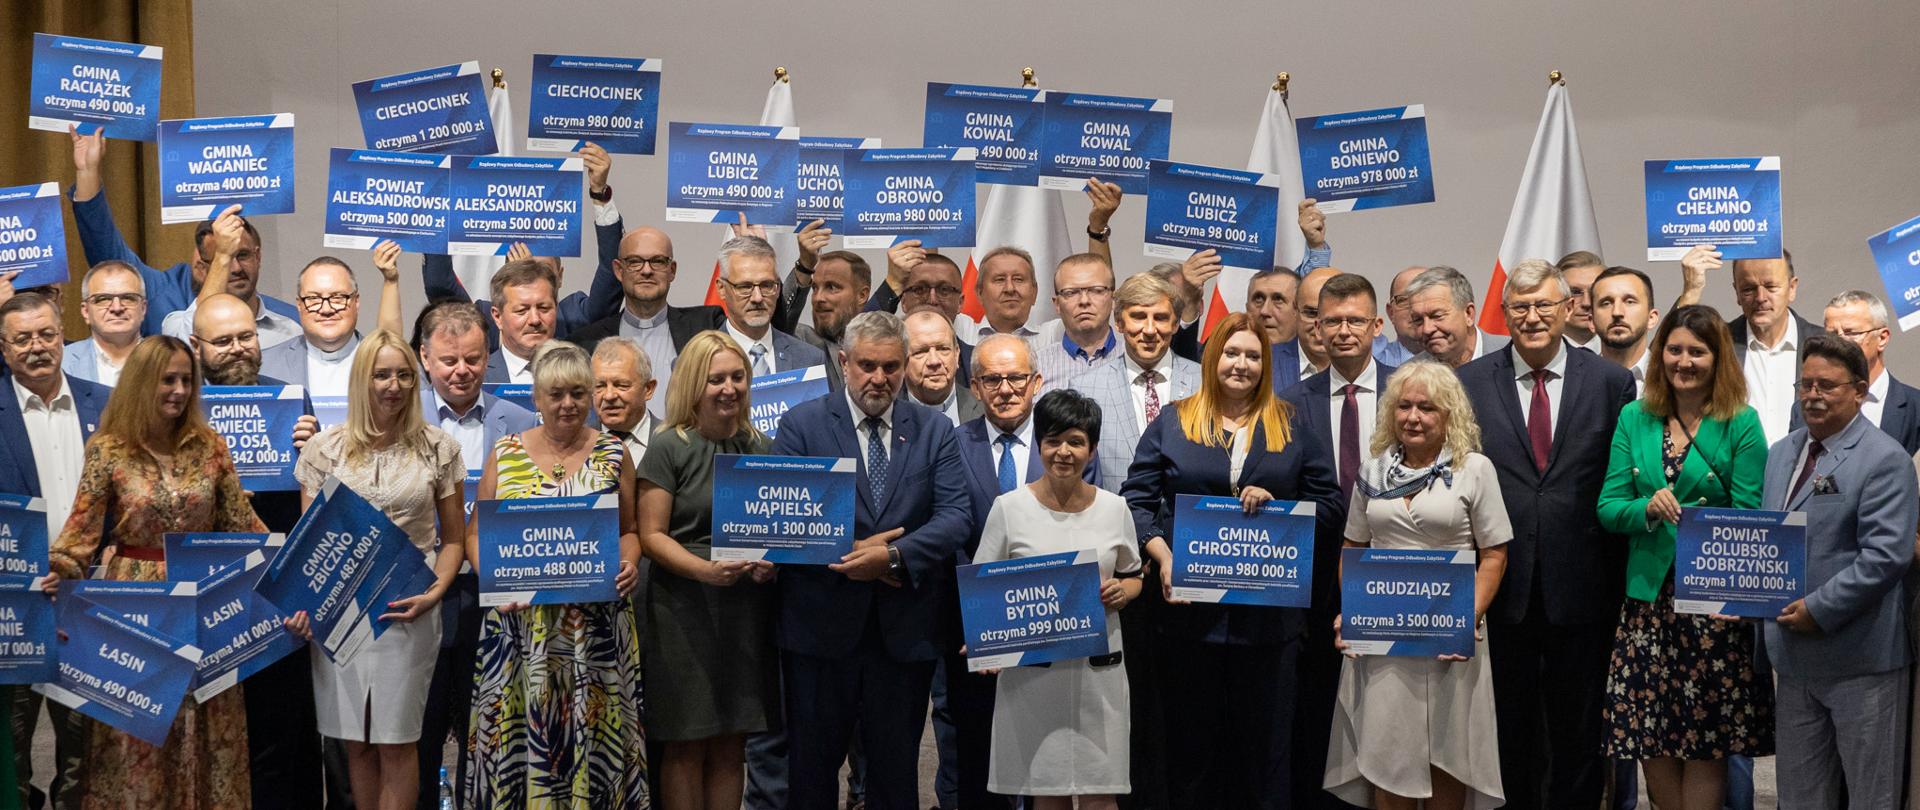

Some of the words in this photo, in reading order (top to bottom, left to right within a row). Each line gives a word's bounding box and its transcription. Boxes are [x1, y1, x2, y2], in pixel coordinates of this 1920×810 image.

[73, 65, 120, 81] GMINA
[61, 78, 131, 98] RACIĄŻEK
[548, 84, 642, 100] CIECHOCINEK
[44, 95, 87, 109] otrzyma
[88, 98, 110, 111] 490
[112, 101, 134, 114] 000
[135, 104, 145, 115] zł
[376, 92, 470, 120] CIECHOCINEK
[543, 115, 585, 128] otrzyma
[587, 115, 608, 128] 980
[611, 116, 632, 129] 000
[634, 118, 643, 129] zł
[966, 112, 1013, 127] GMINA
[375, 134, 418, 149] otrzyma
[419, 129, 426, 141] 1
[428, 125, 449, 139] 200
[451, 121, 473, 135] 000
[474, 119, 485, 131] zł
[964, 126, 1014, 142] KOWAL
[1084, 122, 1130, 137] GMINA
[203, 144, 253, 159] GMINA
[1081, 136, 1131, 151] KOWAL
[1340, 137, 1388, 154] GMINA
[709, 151, 757, 166] GMINA
[981, 145, 1003, 158] 490
[1005, 147, 1026, 160] 000
[1028, 149, 1038, 161] zł
[1331, 150, 1399, 169] BONIEWO
[188, 158, 267, 174] WAGANIEC
[1054, 154, 1096, 167] otrzyma
[1099, 155, 1120, 168] 500
[1122, 156, 1143, 169] 000
[708, 166, 758, 180] LUBICZ
[1317, 176, 1360, 188] otrzyma
[1361, 170, 1383, 183] 978
[1385, 167, 1406, 181] 000
[1408, 166, 1418, 178] zł
[176, 182, 220, 194] otrzyma
[222, 177, 244, 190] 400
[246, 176, 268, 189] 000
[270, 176, 280, 188] zł
[366, 178, 424, 194] POWIAT
[885, 176, 934, 189] GMINA
[488, 184, 545, 198] POWIAT
[681, 184, 724, 198] otrzyma
[726, 185, 748, 197] 490
[750, 185, 772, 198] 000
[774, 187, 784, 199] zł
[876, 191, 943, 204] OBROWO
[1688, 186, 1739, 200] GMINA
[333, 190, 450, 210] ALEKSANDROWSK
[455, 198, 576, 213] ALEKSANDROWSKI
[1188, 192, 1237, 209] GMINA
[1677, 201, 1751, 215] CHEŁMNO
[340, 211, 384, 225] otrzyma
[386, 212, 409, 225] 500
[411, 213, 433, 227] 000
[435, 216, 445, 228] zł
[858, 211, 901, 224] otrzyma
[904, 209, 925, 221] 980
[928, 208, 950, 221] 000
[952, 209, 962, 221] zł
[1187, 206, 1237, 223] LUBICZ
[463, 218, 507, 231] otrzyma
[509, 217, 531, 230] 500
[533, 218, 555, 230] 000
[557, 219, 568, 230] zł
[1662, 223, 1706, 235] otrzyma
[1708, 219, 1731, 232] 400
[1733, 219, 1756, 232] 000
[1757, 219, 1768, 231] zł
[1163, 222, 1205, 237] otrzyma
[1208, 226, 1222, 239] 98
[1225, 228, 1246, 242] 000
[1248, 232, 1258, 244] zł
[18, 246, 41, 260] 000
[210, 404, 261, 419] GMINA
[207, 415, 266, 434] ŚWIECIE
[240, 434, 272, 451] OSĄ
[232, 450, 254, 464] 342
[256, 449, 278, 463] 000
[280, 450, 290, 462] zł
[758, 486, 811, 501] GMINA
[745, 501, 823, 518] WĄPIELSK
[523, 527, 575, 542] GMINA
[722, 522, 768, 536] otrzyma
[772, 521, 778, 534] 1
[782, 521, 805, 535] 300
[808, 522, 831, 536] 000
[834, 524, 845, 536] zł
[1218, 527, 1270, 543] GMINA
[1713, 526, 1769, 542] POWIAT
[303, 531, 339, 576] GMINA
[498, 541, 599, 558] WŁOCŁAWEK
[1189, 540, 1298, 559] CHROSTKOWO
[1702, 541, 1778, 559] GOLUBSKO
[308, 532, 353, 593] ZBICZNO
[494, 566, 541, 578] otrzyma
[543, 562, 566, 575] 488
[569, 560, 592, 574] 000
[595, 561, 605, 573] zł
[1187, 562, 1233, 576] otrzyma
[1236, 562, 1259, 576] 980
[1262, 564, 1284, 578] 000
[1287, 566, 1297, 578] zł
[1691, 556, 1788, 574] -DOBRZYŃSKI
[315, 581, 345, 621] otrzyma
[340, 557, 359, 580] 482
[353, 536, 373, 559] 000
[369, 526, 380, 539] zł
[1366, 581, 1450, 599] GRUDZIĄDZ
[1683, 574, 1726, 589] otrzyma
[1729, 575, 1734, 587] 1
[1738, 575, 1760, 589] 000
[1762, 576, 1784, 590] 000
[1786, 578, 1796, 590] zł
[1005, 585, 1058, 603] GMINA
[1006, 597, 1060, 620] BYTOŃ
[1351, 614, 1394, 628] otrzyma
[1397, 613, 1404, 626] 3
[1407, 614, 1429, 627] 500
[1431, 614, 1453, 627] 000
[1456, 616, 1466, 628] zł
[980, 627, 1026, 642] otrzyma
[1028, 620, 1052, 635] 999
[1055, 617, 1078, 632] 000
[1080, 616, 1091, 628] zł
[99, 643, 145, 673] ŁASIN
[102, 680, 127, 698] 490
[127, 690, 150, 709] 000
